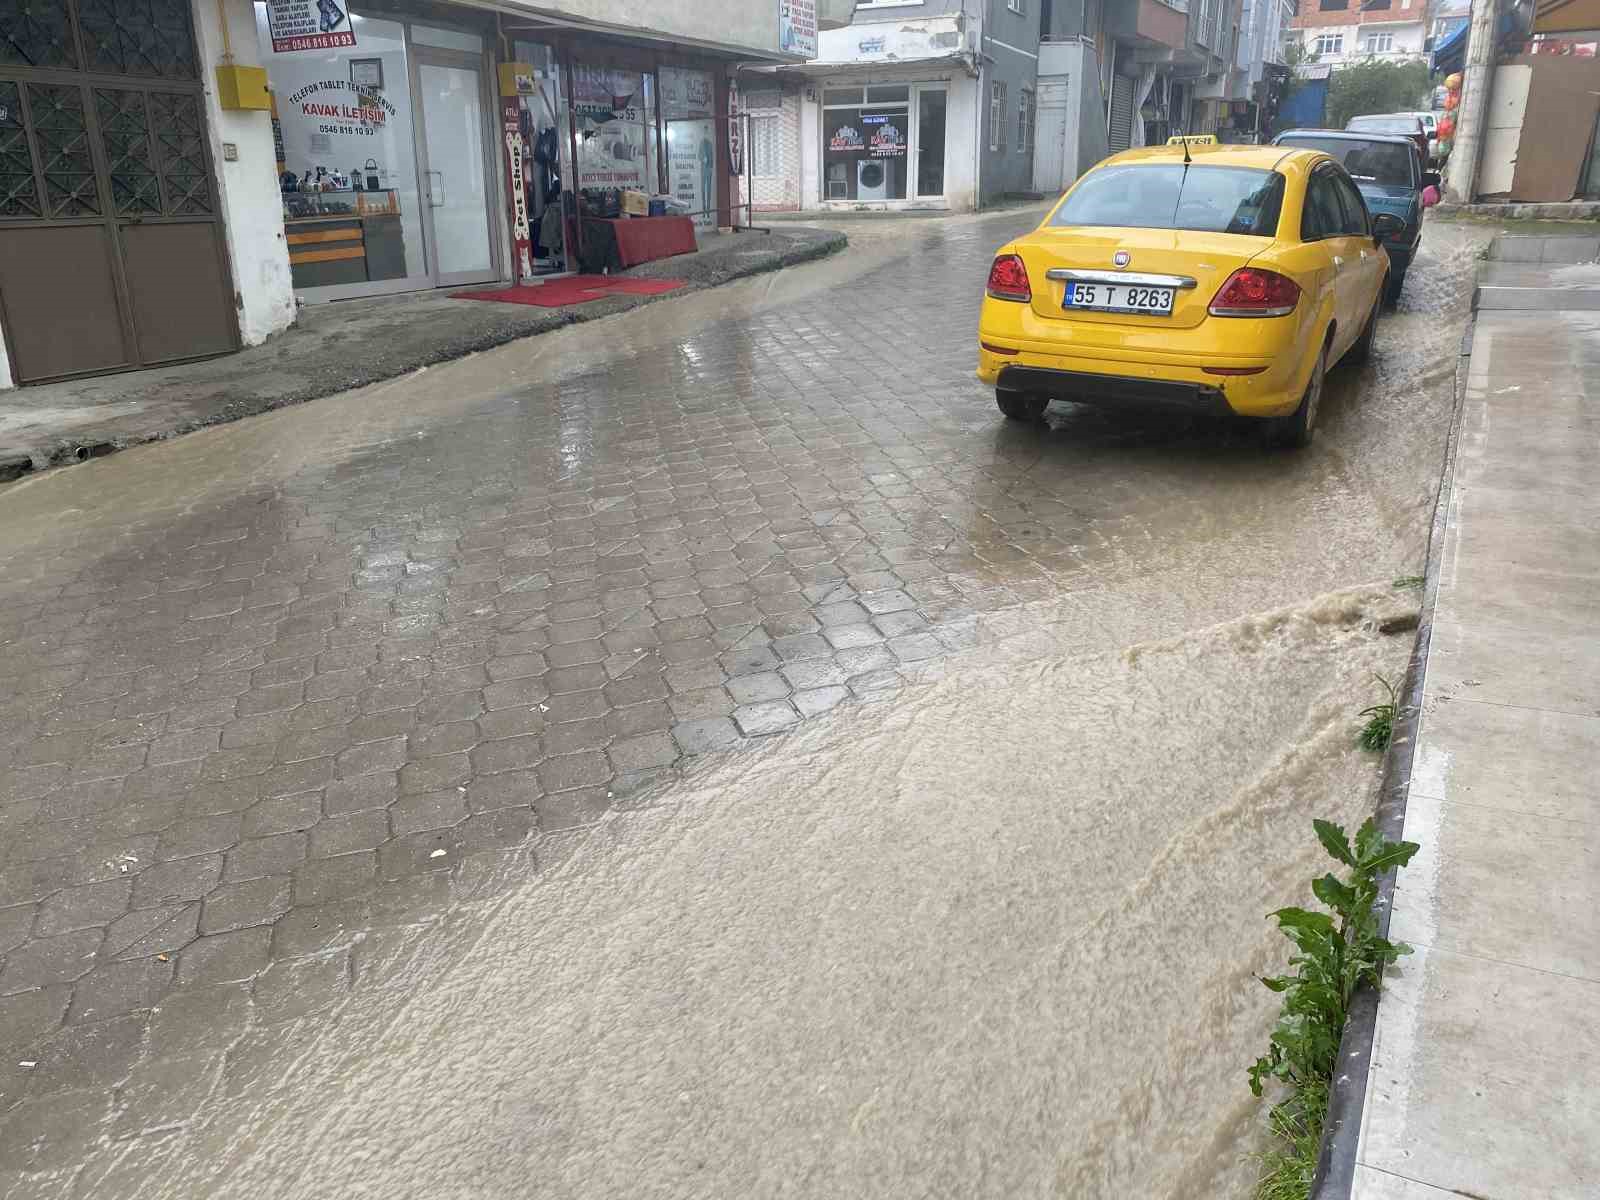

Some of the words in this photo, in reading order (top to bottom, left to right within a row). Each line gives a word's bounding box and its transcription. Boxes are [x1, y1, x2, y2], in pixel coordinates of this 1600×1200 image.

[292, 39, 312, 49] 0546
[313, 38, 328, 48] 816
[330, 36, 340, 46] 10
[341, 34, 352, 45] 93
[289, 84, 319, 105] TELEFON
[319, 80, 345, 90] TABLET
[302, 102, 339, 117] KAVAK
[319, 124, 338, 134] 0546
[339, 125, 353, 135] 816
[355, 127, 363, 136] 10
[365, 127, 374, 136] 93
[513, 146, 522, 191] Shop
[516, 198, 524, 227] Pet
[1075, 285, 1096, 304] 55
[1106, 287, 1116, 304] T
[1127, 288, 1171, 308] 8263
